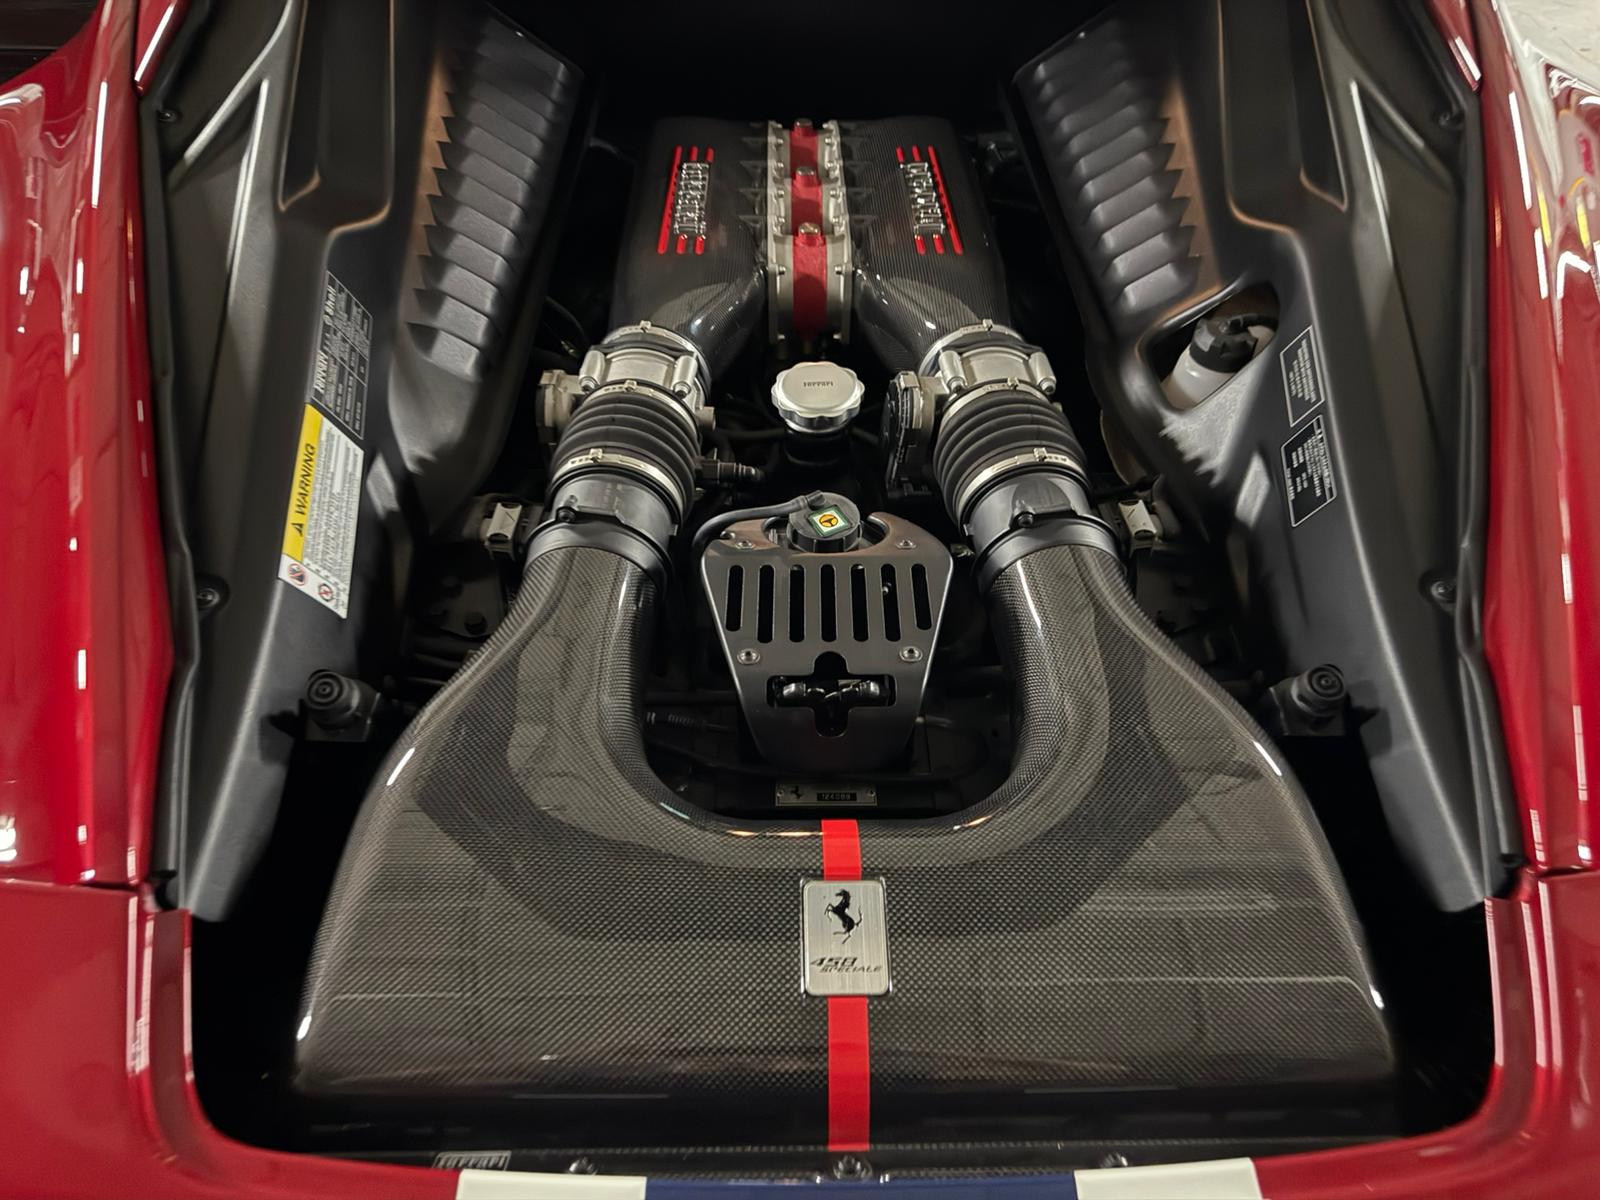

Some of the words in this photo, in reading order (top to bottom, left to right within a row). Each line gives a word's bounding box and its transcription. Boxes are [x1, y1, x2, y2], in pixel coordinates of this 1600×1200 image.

[295, 442, 316, 515] WARNING
[810, 957, 858, 967] 458
[820, 966, 883, 974] SPECIALE
